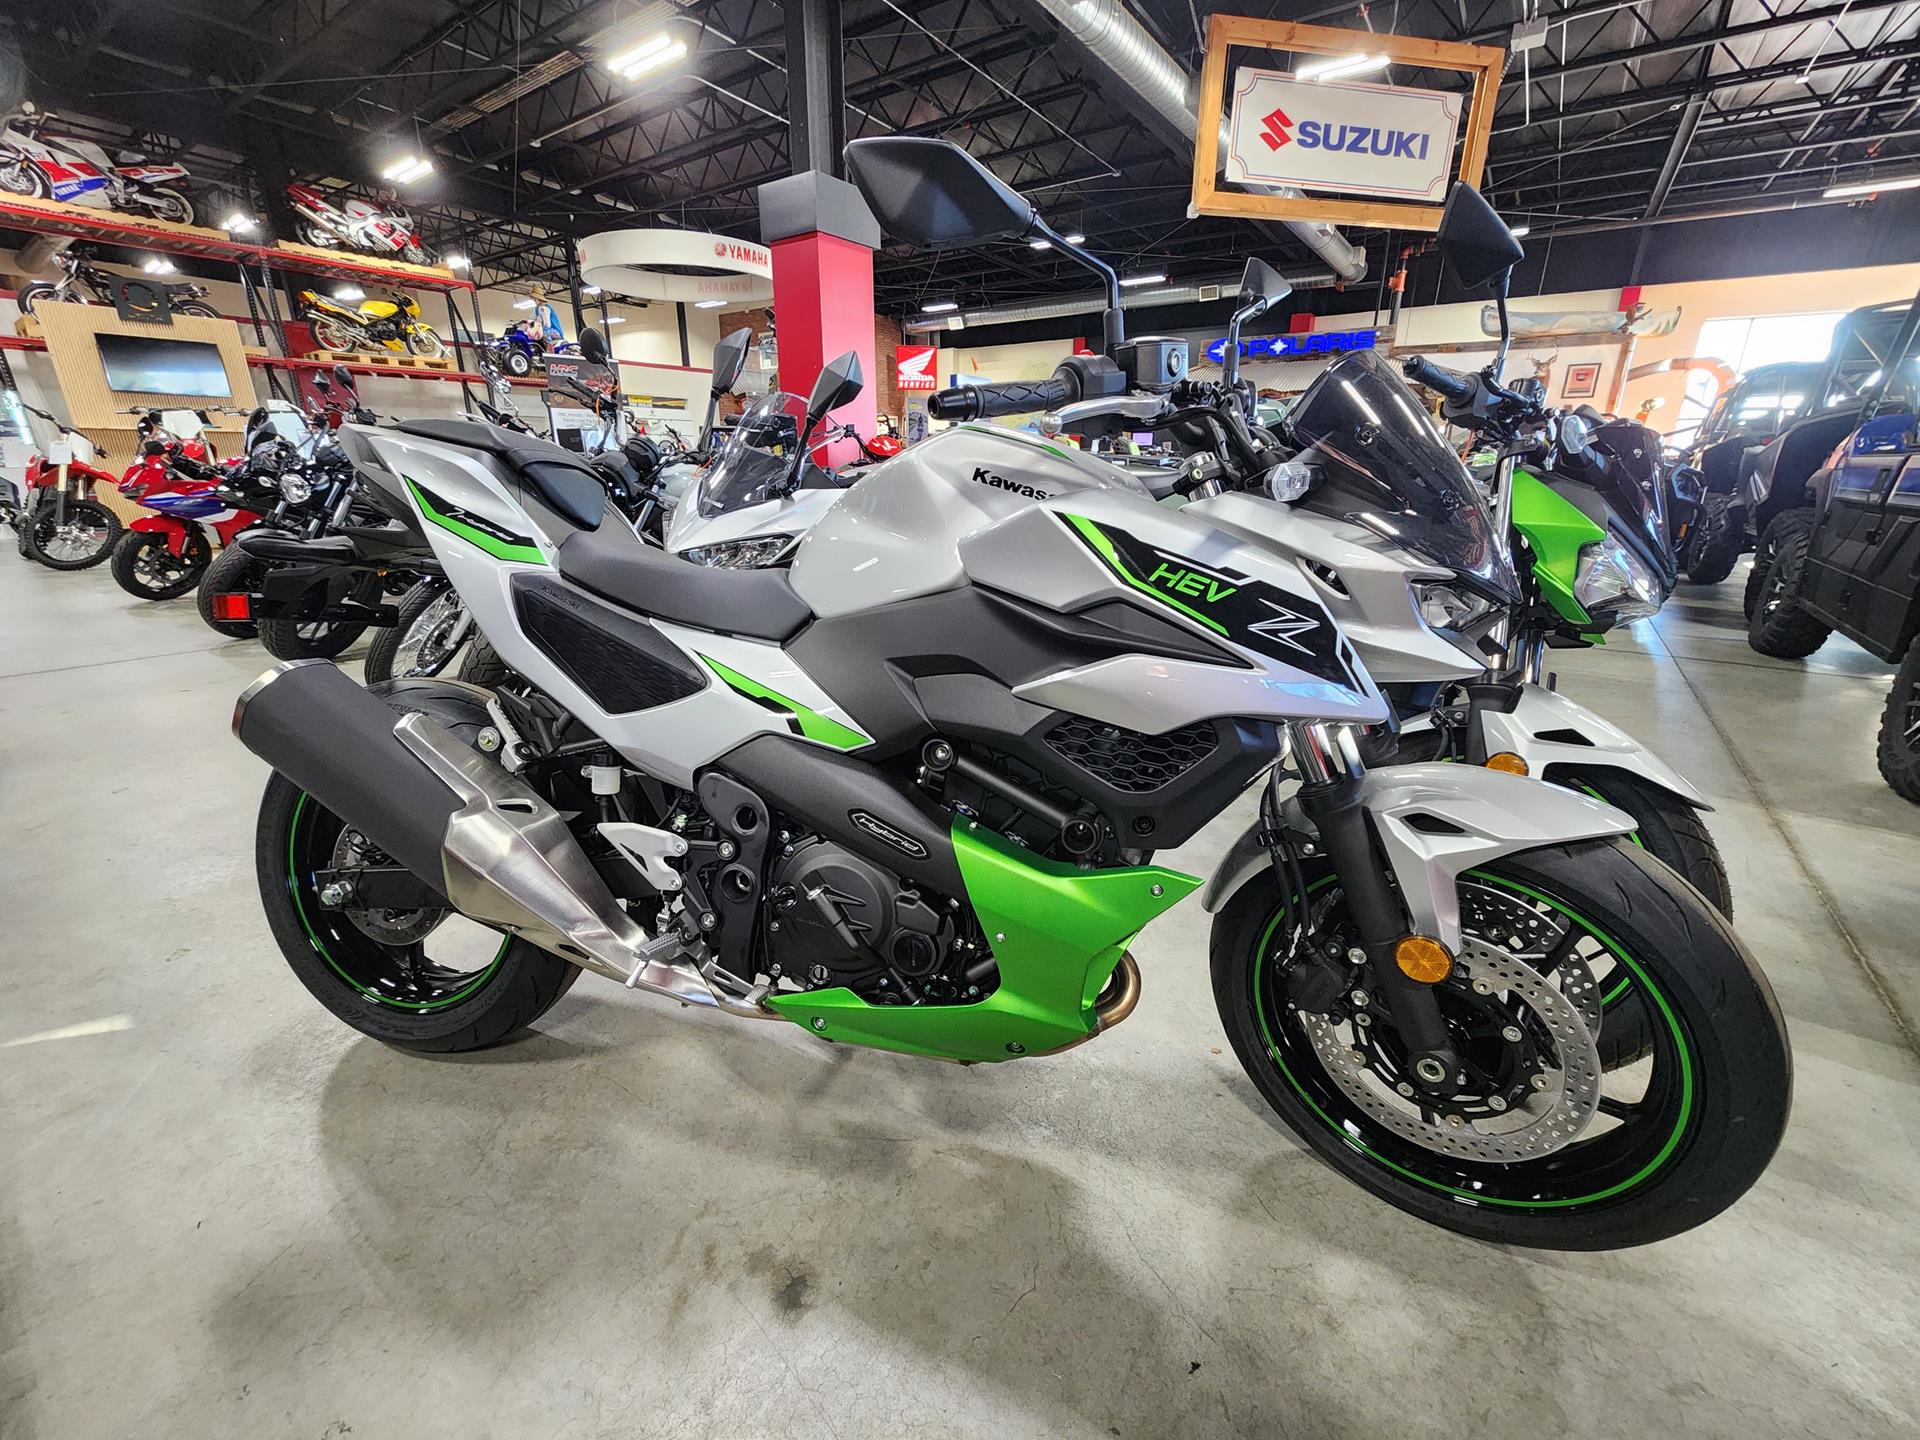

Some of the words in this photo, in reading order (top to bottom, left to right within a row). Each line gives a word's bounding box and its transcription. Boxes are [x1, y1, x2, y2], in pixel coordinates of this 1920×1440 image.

[1297, 120, 1430, 160] SUZUKI
[728, 244, 769, 268] YAMAHA
[1247, 330, 1377, 358] POLARIS
[898, 381, 935, 389] SERVICE
[972, 467, 1057, 501] Kawas
[1149, 562, 1238, 603] HEV
[858, 817, 920, 851] Hybrid
